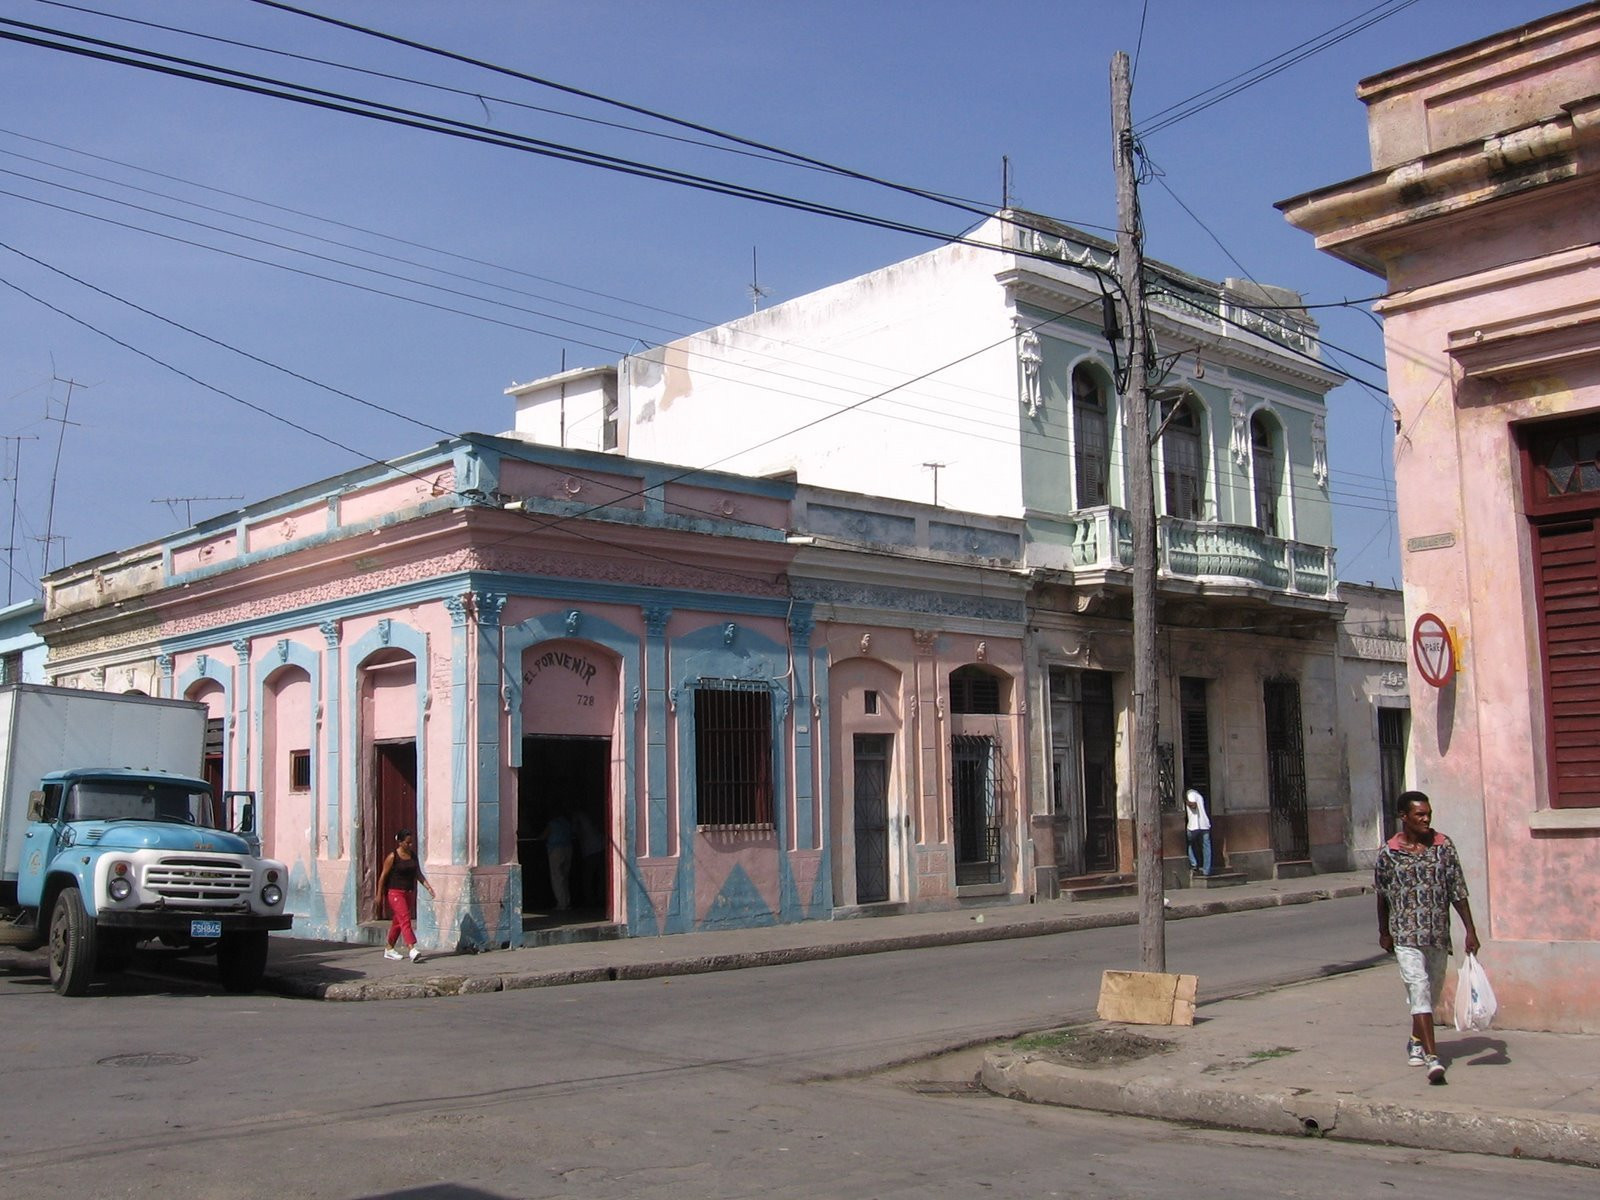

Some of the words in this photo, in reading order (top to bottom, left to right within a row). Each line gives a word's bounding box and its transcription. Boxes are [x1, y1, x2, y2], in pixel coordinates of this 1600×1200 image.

[524, 669, 537, 685] EL
[534, 651, 597, 687] PORVENIR
[577, 694, 595, 706] 728
